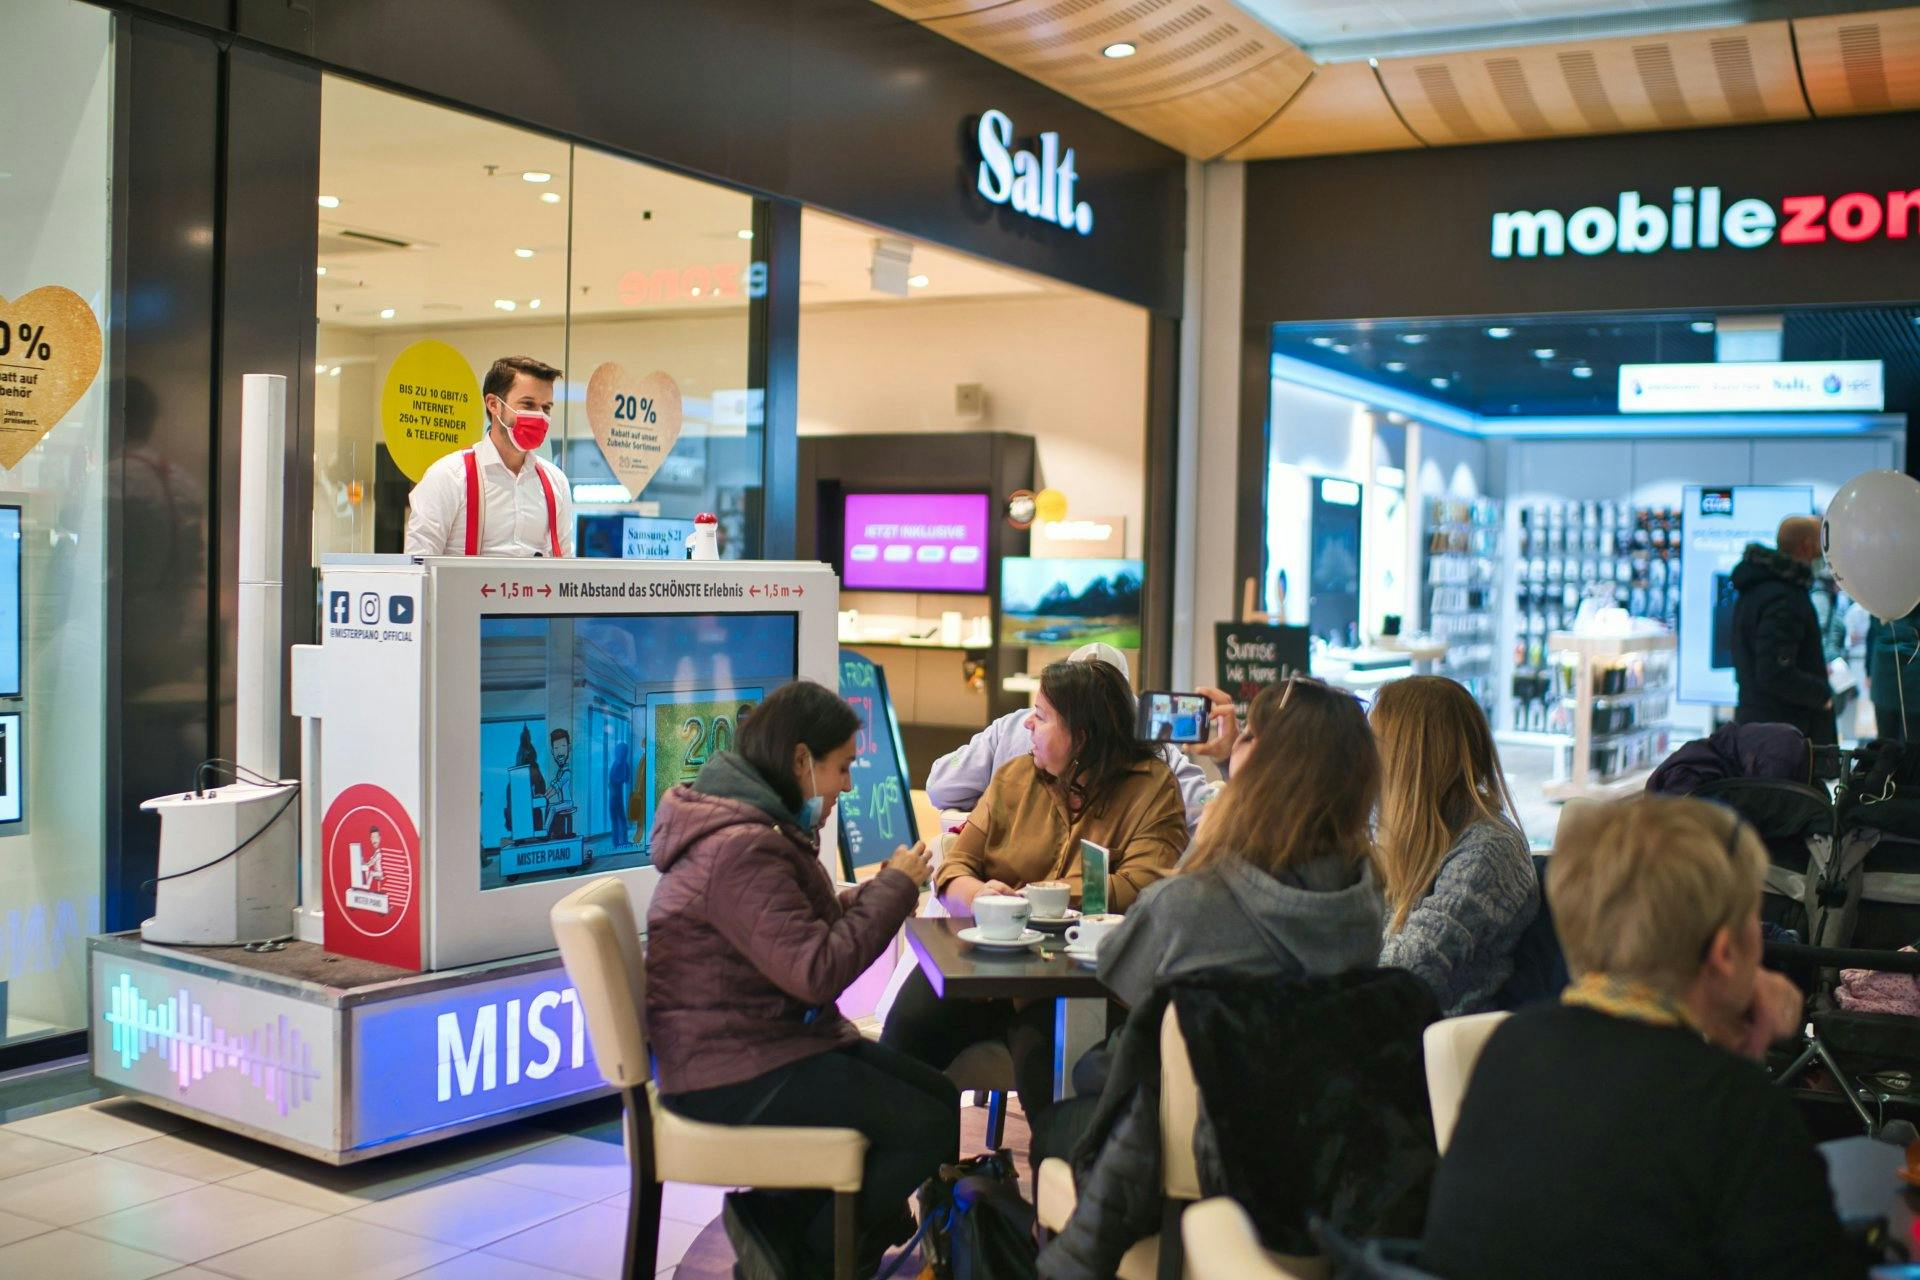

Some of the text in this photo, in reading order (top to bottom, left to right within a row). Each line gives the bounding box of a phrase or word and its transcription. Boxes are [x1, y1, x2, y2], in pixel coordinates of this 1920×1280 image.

[977, 109, 1093, 236] Salt.
[0, 372, 38, 385] att auf
[399, 383, 468, 403] BIS ZU 10 GBIT/S
[399, 413, 466, 430] 250+ TV SENDER
[406, 428, 459, 443] & TELEFONIE
[611, 428, 658, 442] Rabatt auf unser
[607, 438, 661, 452] Zubehör Sortiment
[627, 527, 667, 542] Samsung
[500, 579, 790, 599] 1,5 m Mit Abstand das SCHÖNSTE Erlebnis 1,5 m
[516, 847, 571, 866] MISTER PIANO
